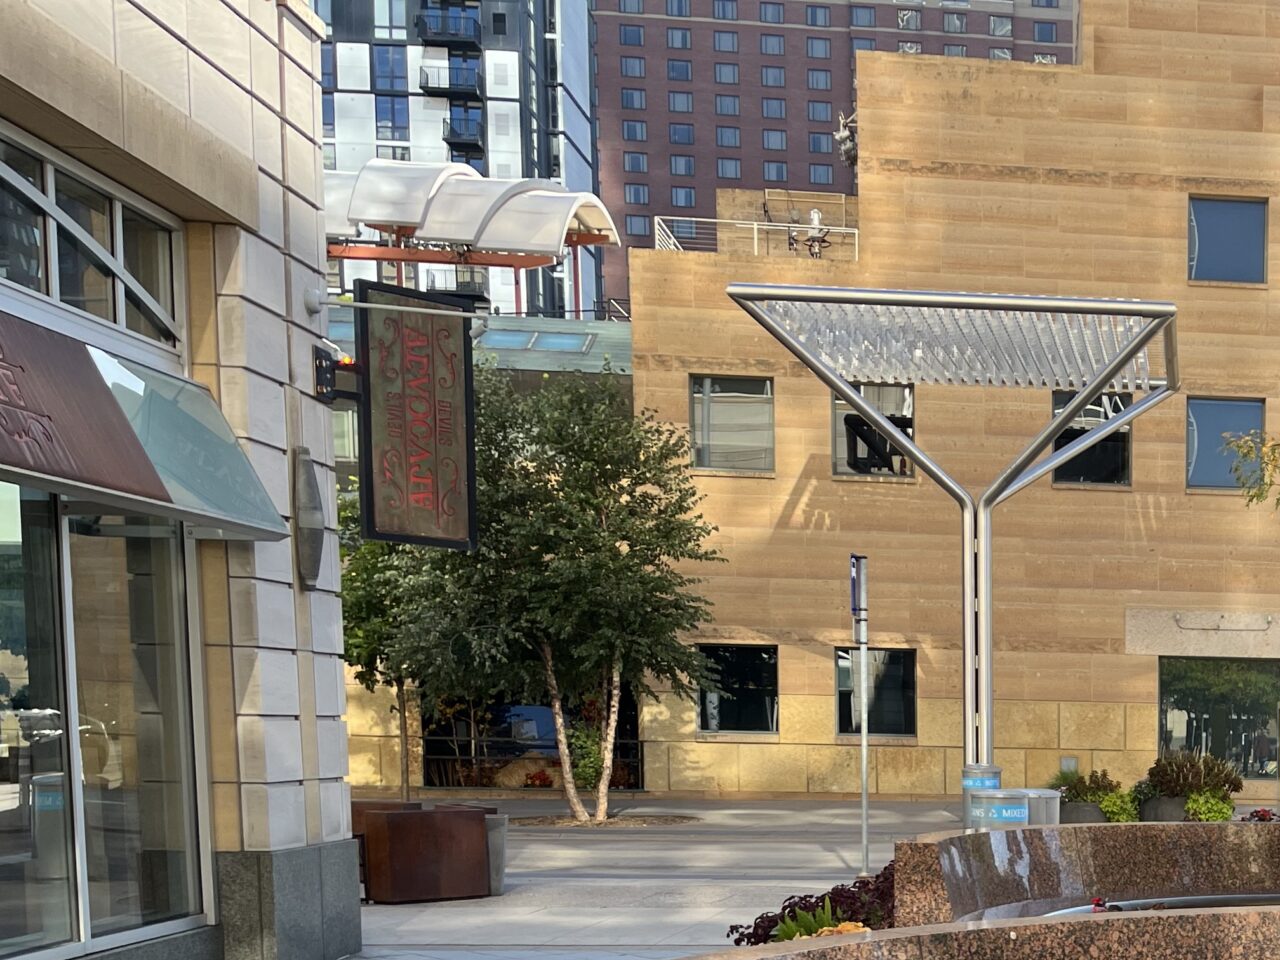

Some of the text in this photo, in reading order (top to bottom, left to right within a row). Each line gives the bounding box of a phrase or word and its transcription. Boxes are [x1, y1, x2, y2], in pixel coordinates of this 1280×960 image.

[386, 391, 402, 439] DEVIL'S
[405, 329, 434, 509] ADVOCATE
[1002, 808, 1025, 817] MIXED
